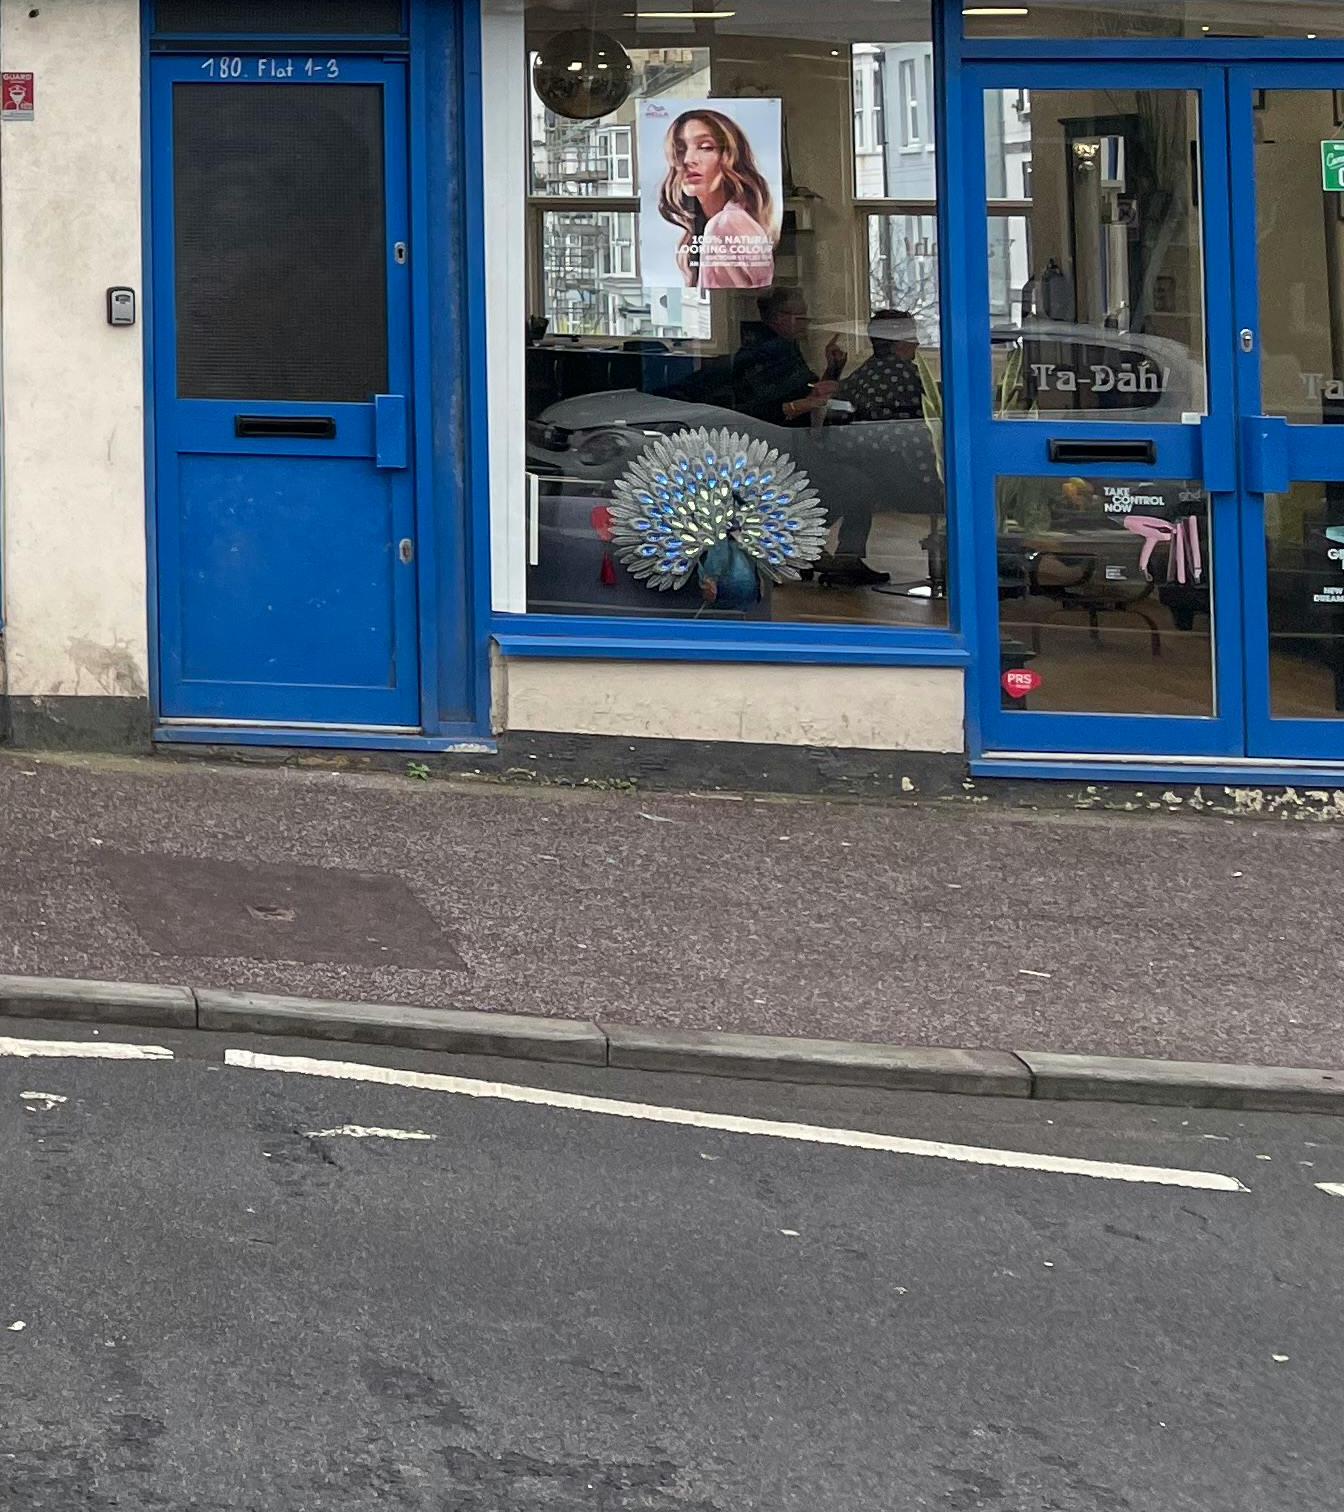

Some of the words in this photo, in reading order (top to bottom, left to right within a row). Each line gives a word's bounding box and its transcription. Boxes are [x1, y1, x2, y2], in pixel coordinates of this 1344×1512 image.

[258, 58, 295, 78] Flat
[303, 57, 340, 78] 1-3
[692, 235, 723, 244] 100%
[724, 235, 774, 245] NATURAL
[729, 245, 773, 254] COLOUR
[1104, 486, 1131, 497] TAKE
[1112, 495, 1165, 506] CONTROL
[1104, 503, 1133, 513] NOW
[1007, 673, 1032, 684] PRS
